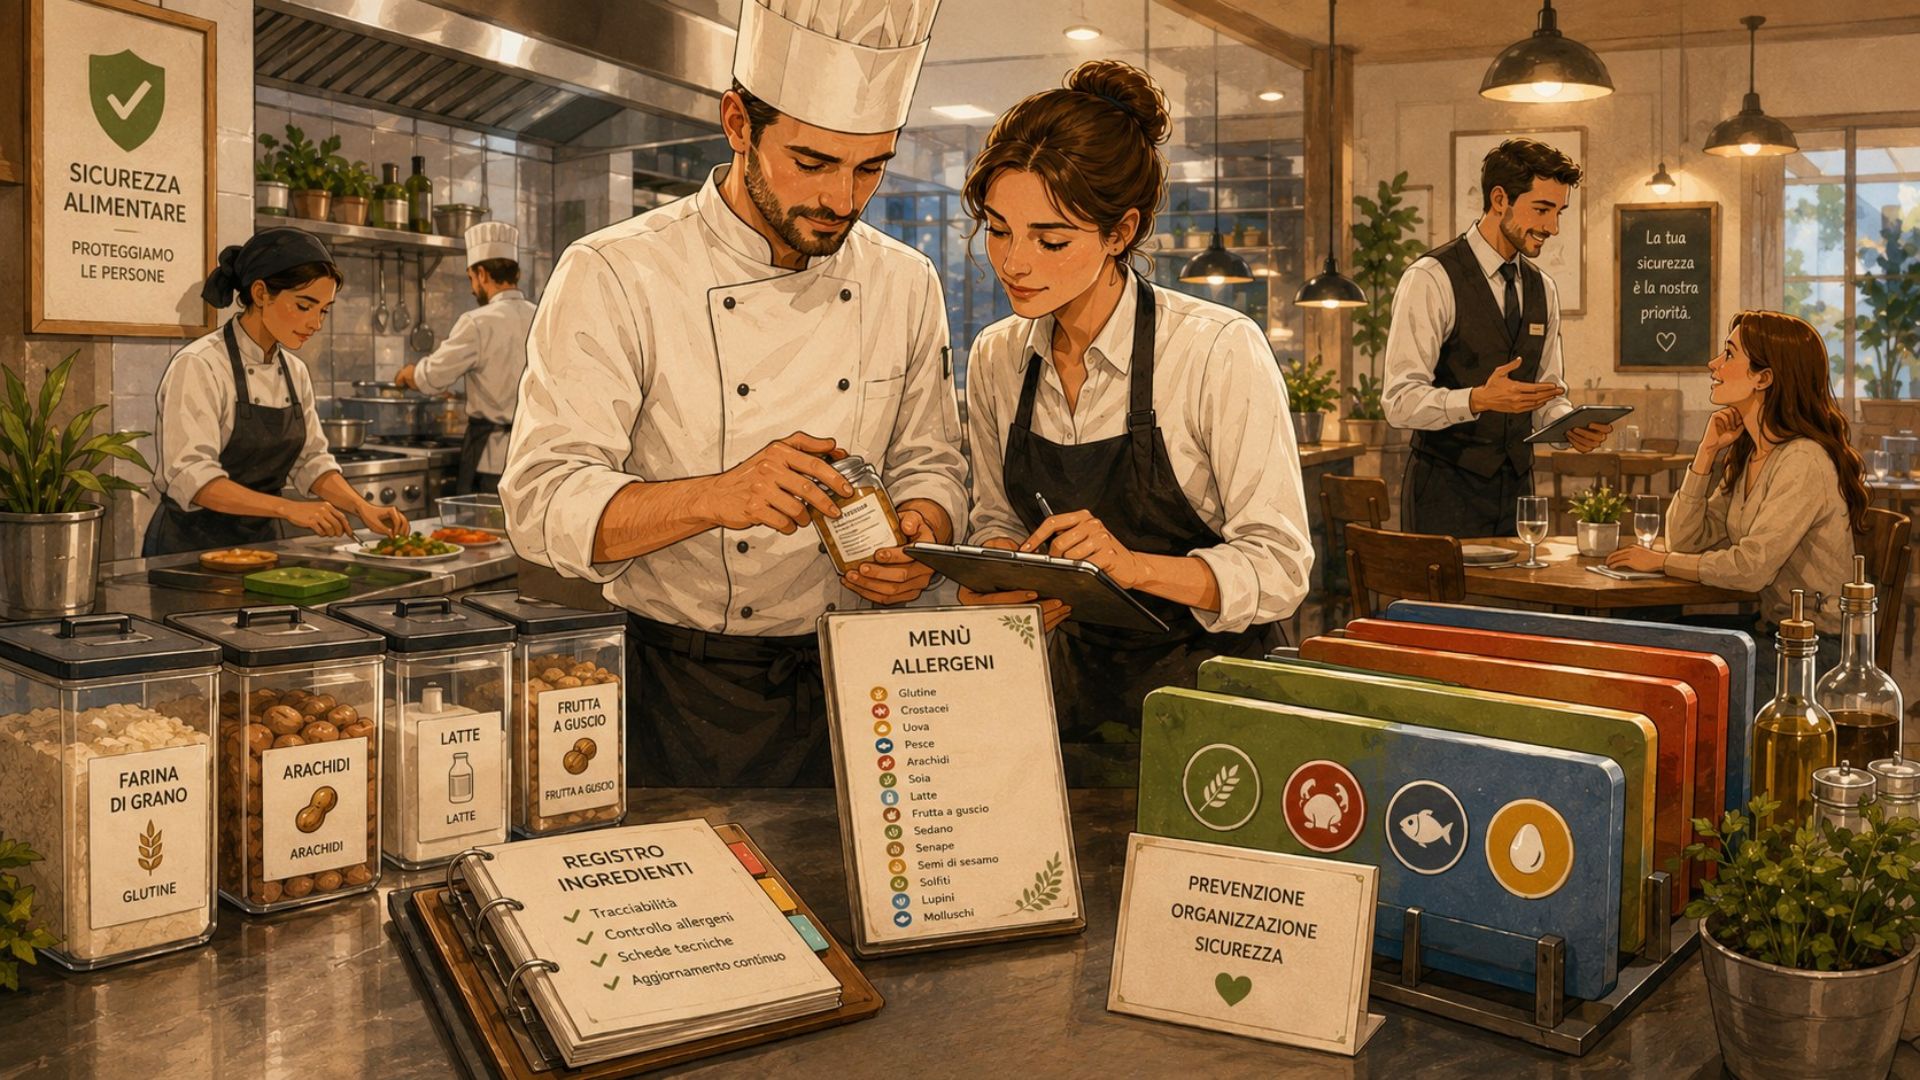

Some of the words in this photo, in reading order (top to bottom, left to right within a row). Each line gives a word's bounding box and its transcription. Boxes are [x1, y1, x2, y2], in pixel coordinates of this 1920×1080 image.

[69, 162, 181, 195] SICUREZZA
[63, 191, 187, 223] ALIMENTARE
[1646, 230, 1661, 245] La
[1666, 229, 1686, 244] tua
[71, 240, 174, 262] PROTEGGIAMO
[1637, 256, 1695, 270] sicurezza
[81, 264, 97, 279] LE
[101, 265, 165, 283] PERSONE
[1644, 279, 1656, 294] la
[1659, 280, 1699, 294] nostra
[908, 624, 972, 648] MENÙ
[891, 654, 995, 675] ALLERGENI
[898, 687, 937, 698] Glutine
[557, 697, 601, 715] FRUTTA
[900, 704, 949, 716] Crostacei
[553, 720, 562, 733] A
[564, 714, 606, 731] GUSCIO
[902, 722, 930, 732] Uova
[441, 728, 480, 745] LATTE
[904, 739, 935, 750] Pesce
[283, 757, 350, 780] ARACHIDI
[906, 755, 950, 766] Arachidi
[119, 766, 179, 789] FARINA
[908, 773, 931, 783] Soia
[110, 796, 126, 813] DI
[131, 787, 188, 810] GRANO
[545, 787, 577, 801] FRUTTA
[578, 786, 584, 794] A
[585, 780, 615, 793] GUSCIO
[910, 790, 938, 801] Latte
[446, 810, 476, 825] LATTE
[912, 809, 944, 818] Frutta
[946, 808, 953, 816] a
[955, 804, 990, 818] guscio
[913, 825, 954, 836] Sedano
[290, 841, 344, 860] ARACHIDI
[915, 842, 955, 853] Senape
[562, 845, 665, 870] REGISTRO
[917, 860, 944, 870] Semi
[947, 857, 957, 867] di
[959, 856, 999, 867] sesamo
[557, 861, 694, 893] INGREDIENTI
[919, 876, 951, 888] Solfiti
[122, 882, 177, 903] GLUTINE
[921, 893, 955, 906] Lupini
[1188, 875, 1306, 908] PREVENZIONE
[588, 897, 679, 920] Tracciabilità
[923, 908, 975, 922] Molluschi
[604, 923, 673, 941] Controllo
[676, 911, 735, 931] allergeni
[1171, 902, 1318, 940] ORGANIZZAZIONE
[617, 944, 672, 964] Schede
[674, 935, 735, 954] tecniche
[1195, 935, 1284, 965] SICUREZZA
[631, 961, 732, 987] Aggiornamento
[733, 951, 787, 969] continuo
